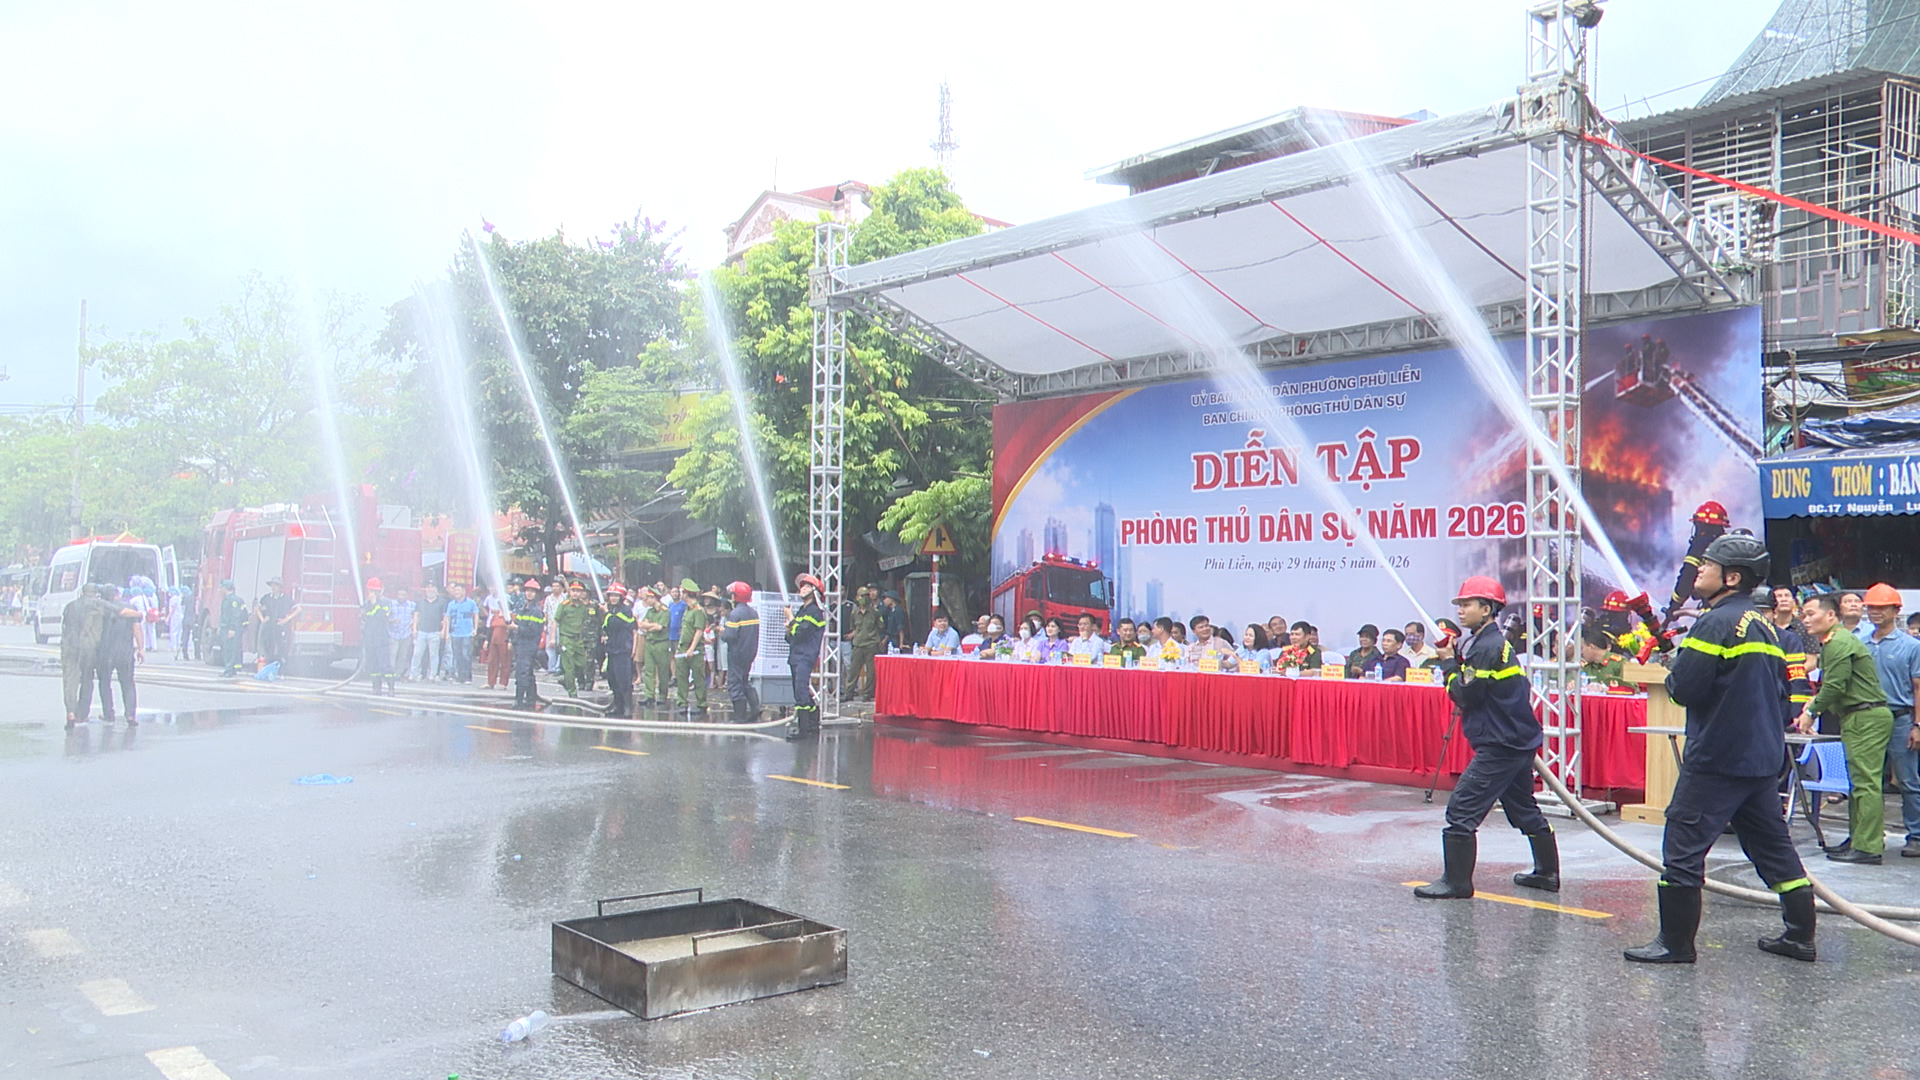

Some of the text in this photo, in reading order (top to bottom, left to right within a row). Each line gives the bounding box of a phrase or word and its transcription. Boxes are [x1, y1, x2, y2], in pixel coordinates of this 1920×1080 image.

[1210, 391, 1233, 404] BAN
[1272, 381, 1299, 397] DÂN
[1302, 376, 1356, 394] PHƯỜNG
[1360, 370, 1387, 387] PHÙ
[1390, 364, 1421, 384] LIỄN
[1203, 413, 1227, 425] BAN
[1278, 402, 1321, 416] PHÒNG
[1324, 395, 1350, 412] THỦ
[1354, 394, 1382, 410] DÂN
[1386, 393, 1406, 410] SỰ
[1192, 429, 1421, 491] DIỄN TẬP
[1771, 467, 1812, 498] DUNG
[1831, 462, 1873, 497] THƠM
[1889, 455, 1920, 495] BÁN
[1121, 502, 1526, 547] PHÒNG THỦ DÂN SỰ NĂM 2026
[1807, 504, 1842, 513] ĐC.17
[1847, 499, 1894, 513] Nguyễn
[1204, 554, 1410, 573] Phù Liễn, ngày 29 tháng 5 năm 026
